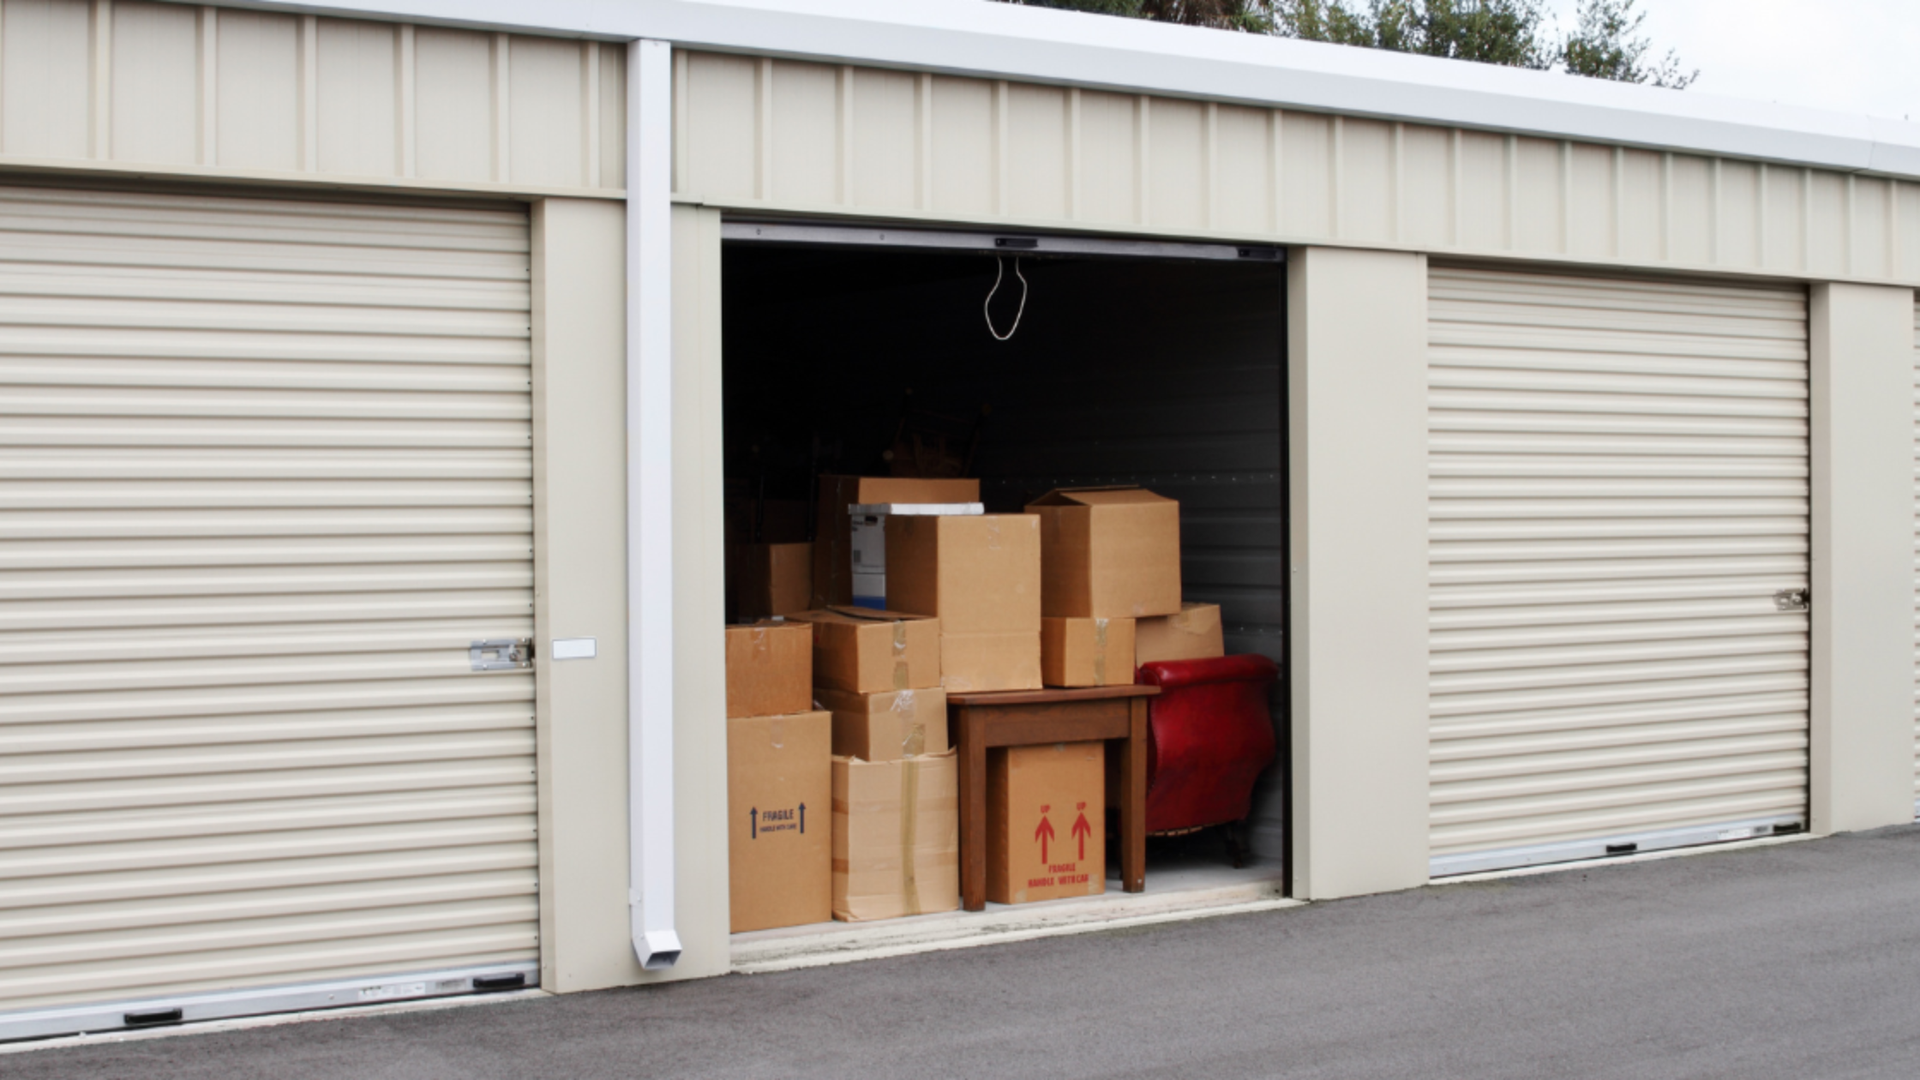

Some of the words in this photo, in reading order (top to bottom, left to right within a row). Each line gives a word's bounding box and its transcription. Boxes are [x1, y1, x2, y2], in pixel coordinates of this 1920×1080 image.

[1040, 804, 1051, 814] UP
[1076, 801, 1087, 811] UP
[762, 809, 794, 821] FRAGILE
[1048, 863, 1076, 874] FRAGILE
[1027, 876, 1055, 888] HANDLE
[1058, 875, 1076, 885] WITH
